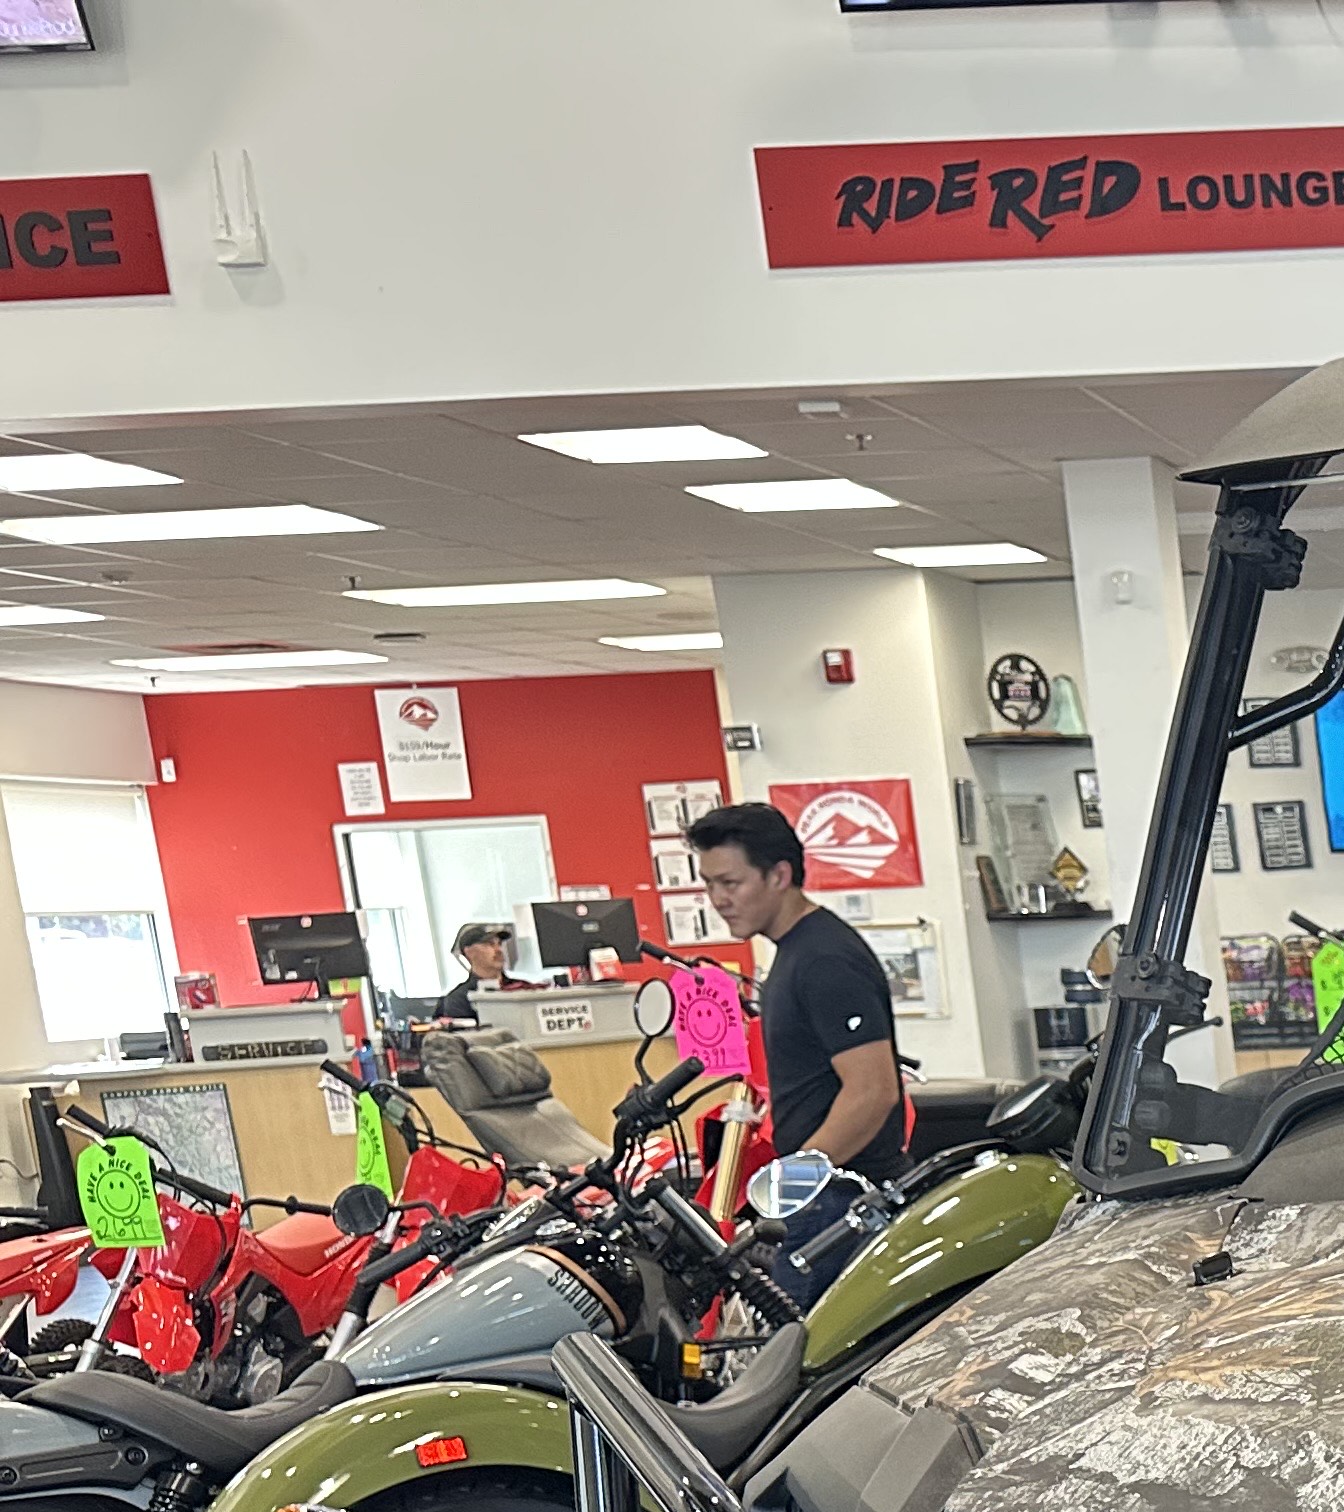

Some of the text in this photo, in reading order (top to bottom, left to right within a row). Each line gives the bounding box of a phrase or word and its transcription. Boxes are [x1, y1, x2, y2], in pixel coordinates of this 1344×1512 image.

[836, 160, 980, 235] RIDE
[987, 155, 1142, 242] RED
[0, 208, 121, 269] CE
[541, 1004, 589, 1018] SERVICE
[87, 1172, 98, 1203] HAVE
[109, 1158, 132, 1171] NICE
[547, 1269, 609, 1330] SHADOW
